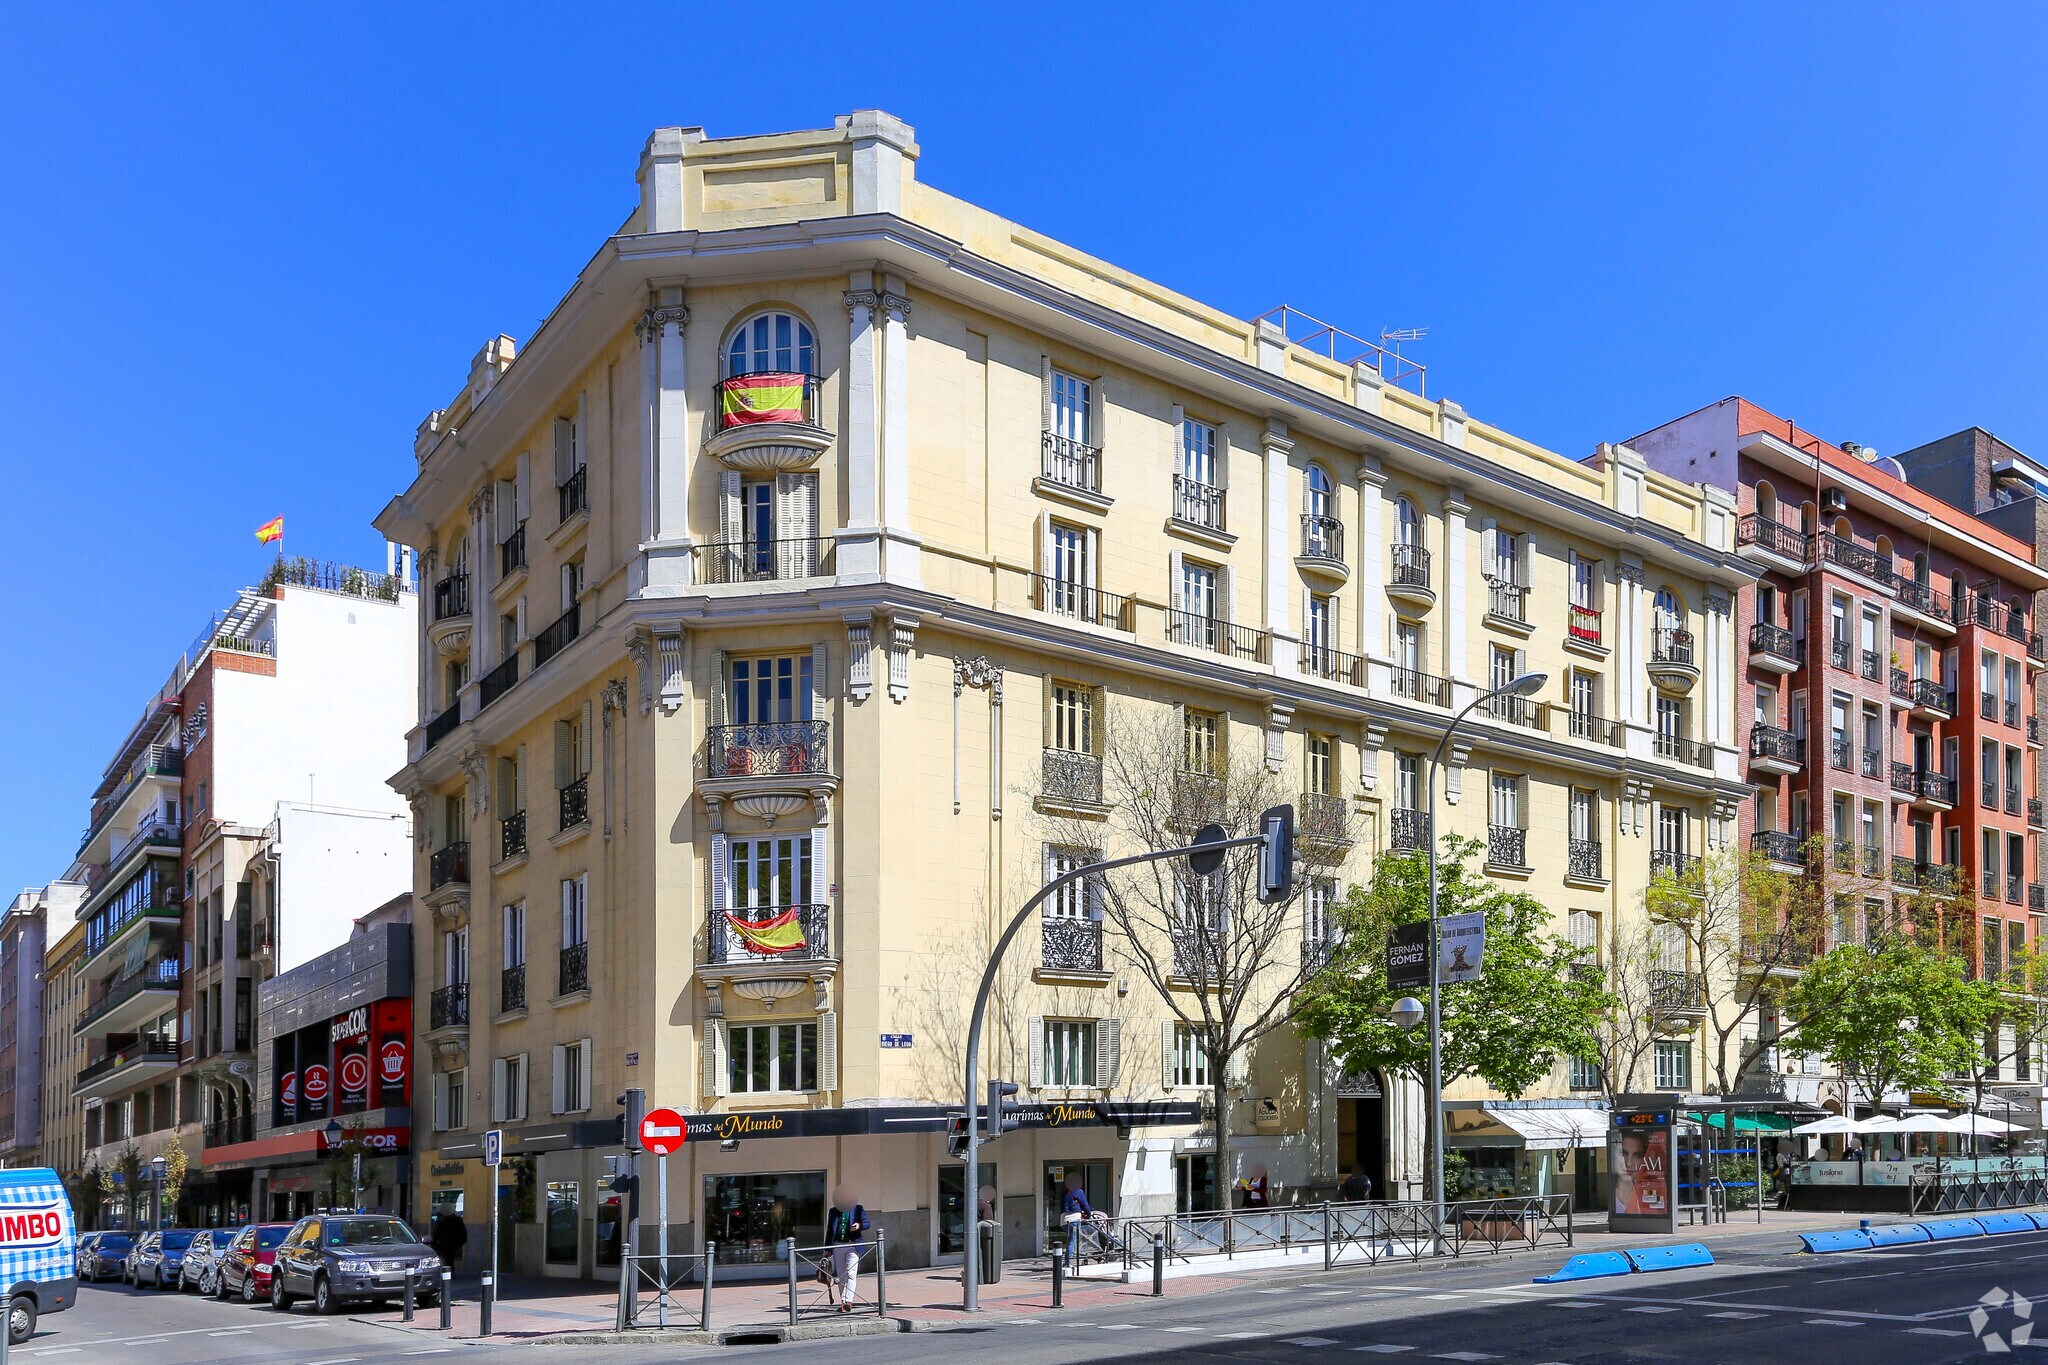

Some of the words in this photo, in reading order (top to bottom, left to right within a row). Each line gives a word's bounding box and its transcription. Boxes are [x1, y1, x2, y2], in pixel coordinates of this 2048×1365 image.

[1457, 926, 1480, 936] ARQUITECTURA
[1389, 942, 1424, 956] FERNÁN
[1390, 953, 1424, 966] GÓMEZ
[1050, 1105, 1096, 1126] Mundo
[714, 1123, 724, 1132] del
[720, 1115, 783, 1138] Mundo
